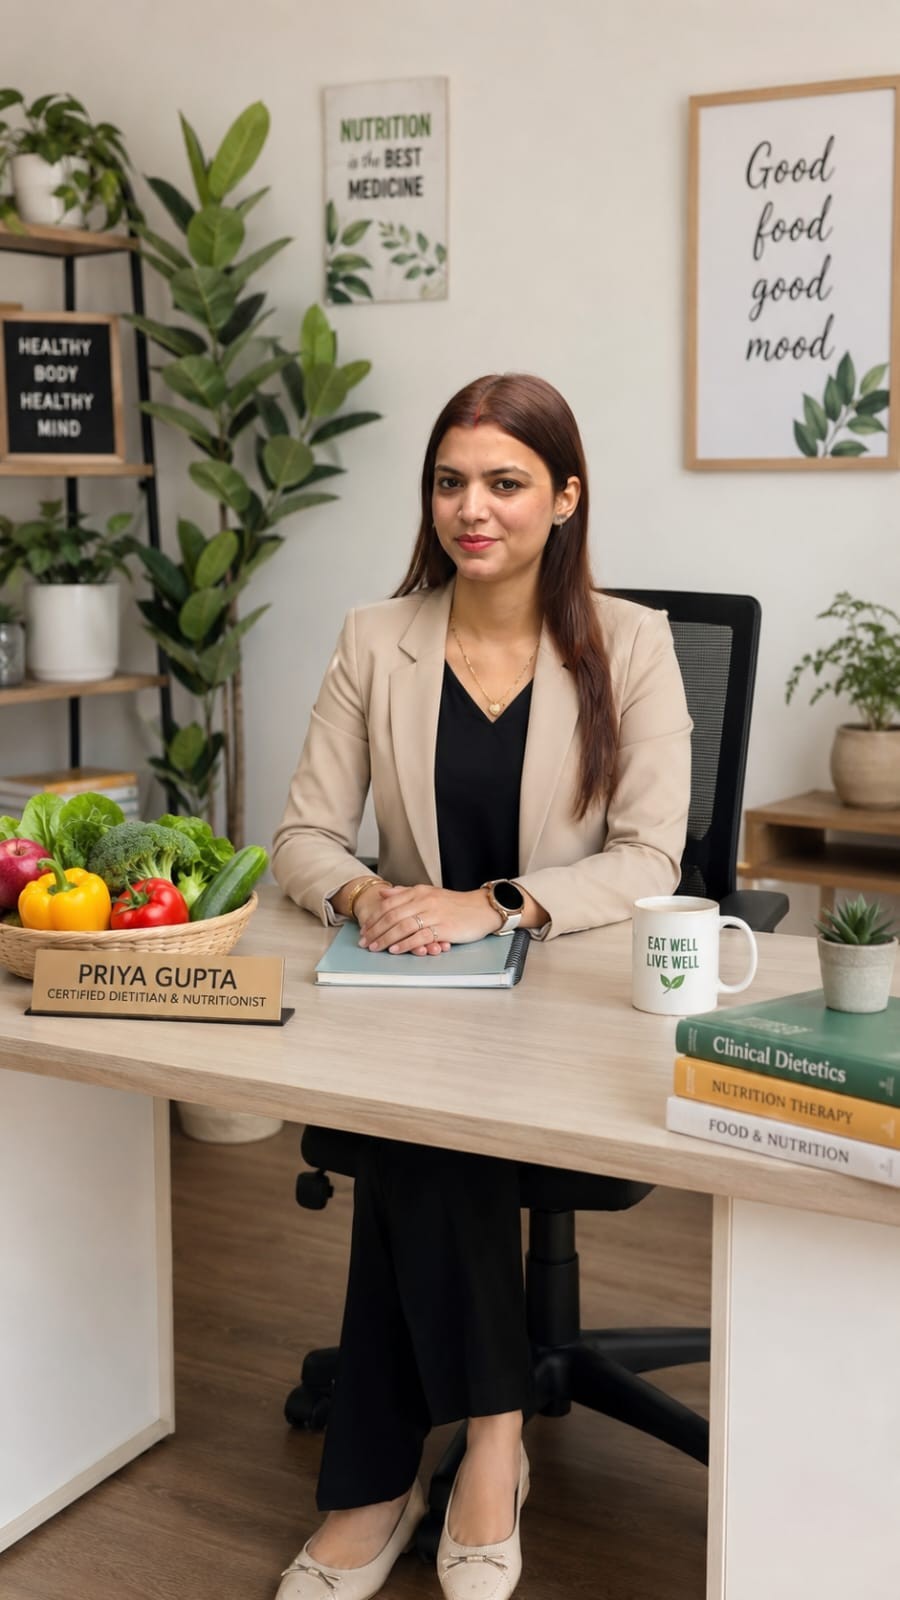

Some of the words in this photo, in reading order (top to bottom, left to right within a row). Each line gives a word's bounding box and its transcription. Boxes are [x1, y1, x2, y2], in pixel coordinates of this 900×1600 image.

[340, 113, 431, 142] NUTRITION
[348, 155, 358, 169] is
[361, 152, 380, 169] the
[385, 147, 422, 168] BEST
[746, 135, 835, 189] Good
[348, 176, 424, 200] MEDICINE
[753, 194, 832, 261] food
[749, 254, 832, 321] good
[18, 337, 92, 356] HEALTHY
[746, 314, 835, 361] mood
[33, 364, 78, 382] BODY
[20, 392, 94, 410] HEALTHY
[37, 419, 82, 437] MIND
[648, 936, 667, 951] EAT
[670, 938, 698, 952] WELL
[646, 953, 668, 969] LIVE
[671, 955, 699, 969] WELL
[78, 963, 147, 986] PRIYA
[155, 966, 237, 990] GUPTA
[47, 988, 105, 1001] CERTIFIED
[110, 990, 167, 1003] DIETITIAN
[171, 994, 178, 1004] &
[183, 994, 267, 1007] NUTRITIONIST
[713, 1036, 770, 1065] Clinical
[775, 1049, 846, 1084] Dietetics
[712, 1079, 786, 1108] NUTRITION
[790, 1098, 853, 1125] THERAPY
[708, 1118, 748, 1139] FOOD
[753, 1130, 762, 1143] &
[767, 1132, 849, 1164] NUTRITION
